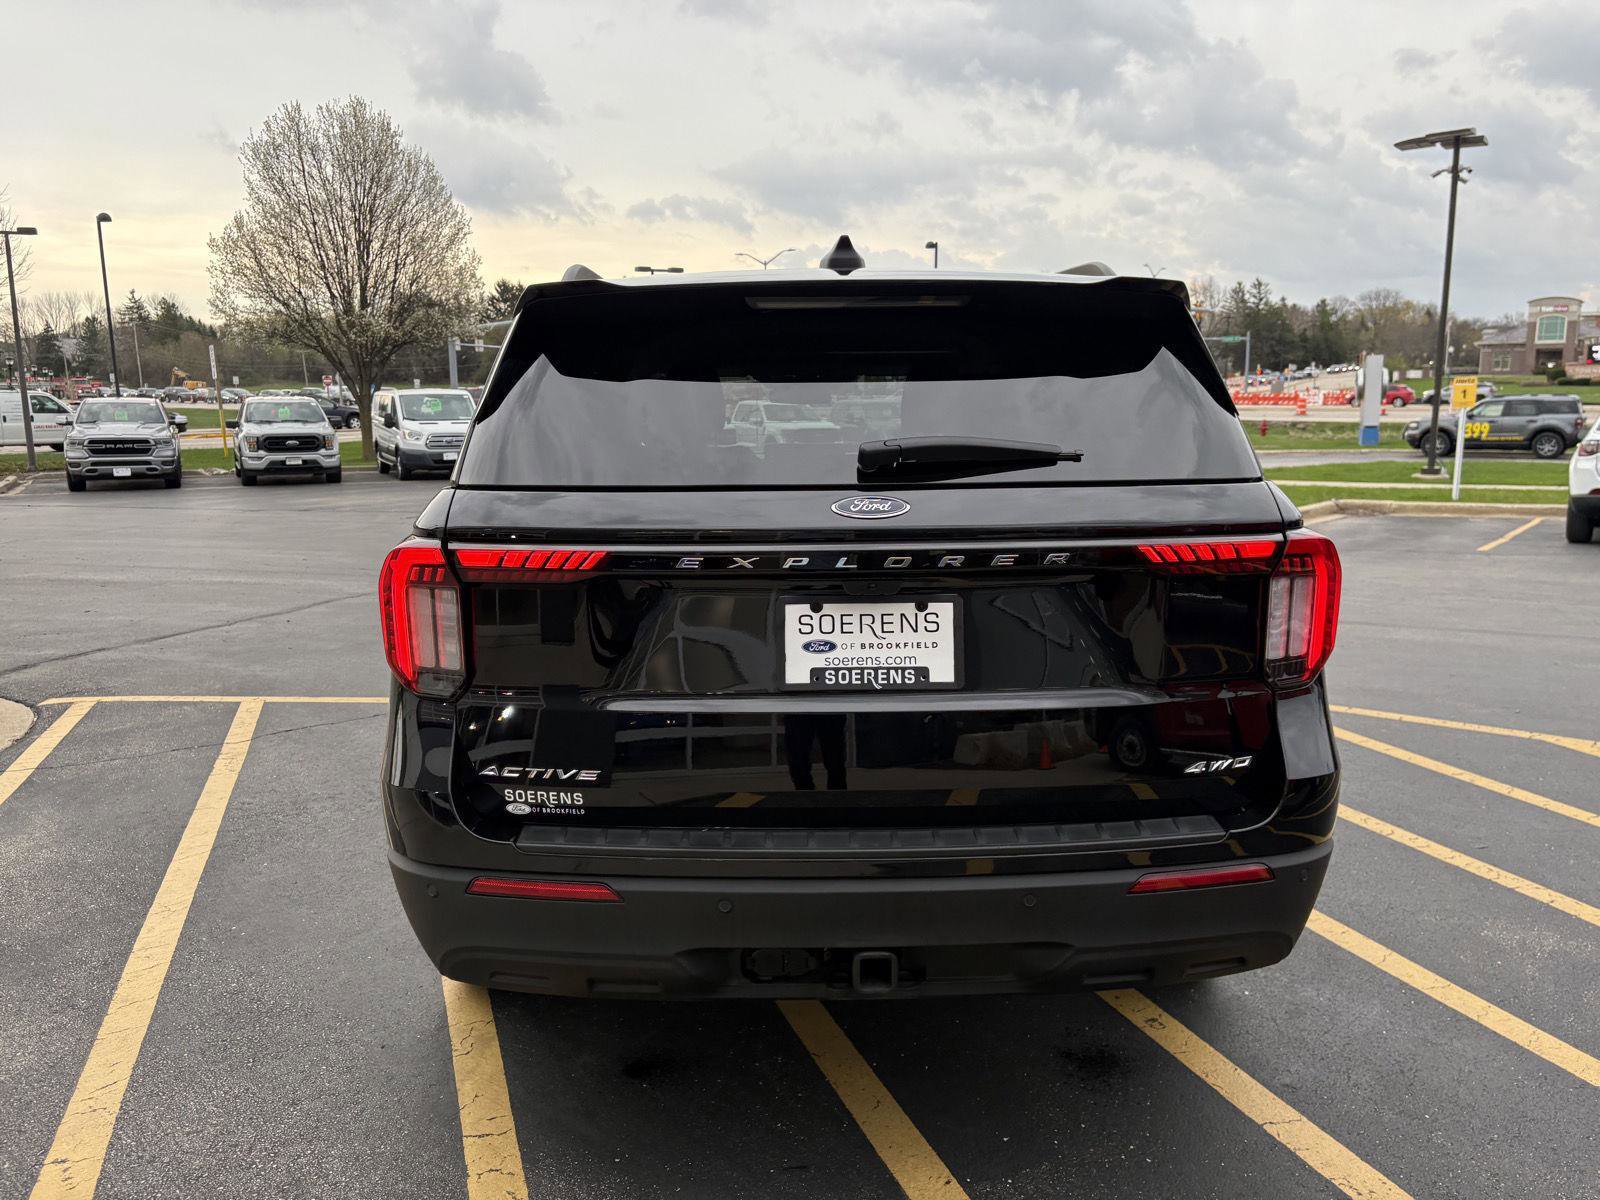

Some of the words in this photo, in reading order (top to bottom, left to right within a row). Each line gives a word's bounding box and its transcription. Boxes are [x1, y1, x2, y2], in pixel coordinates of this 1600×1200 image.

[1465, 422, 1490, 441] 399
[675, 552, 1071, 570] EXPLORER
[798, 612, 941, 640] SOERENS
[860, 641, 939, 650] BROOKFIELD
[824, 655, 917, 667] soerens.com
[824, 669, 916, 690] SOERENS
[478, 765, 602, 782] ACTIVE
[1184, 755, 1253, 774] 4WD
[504, 789, 584, 808] SOERENS
[542, 807, 586, 815] BROOKFIELD
